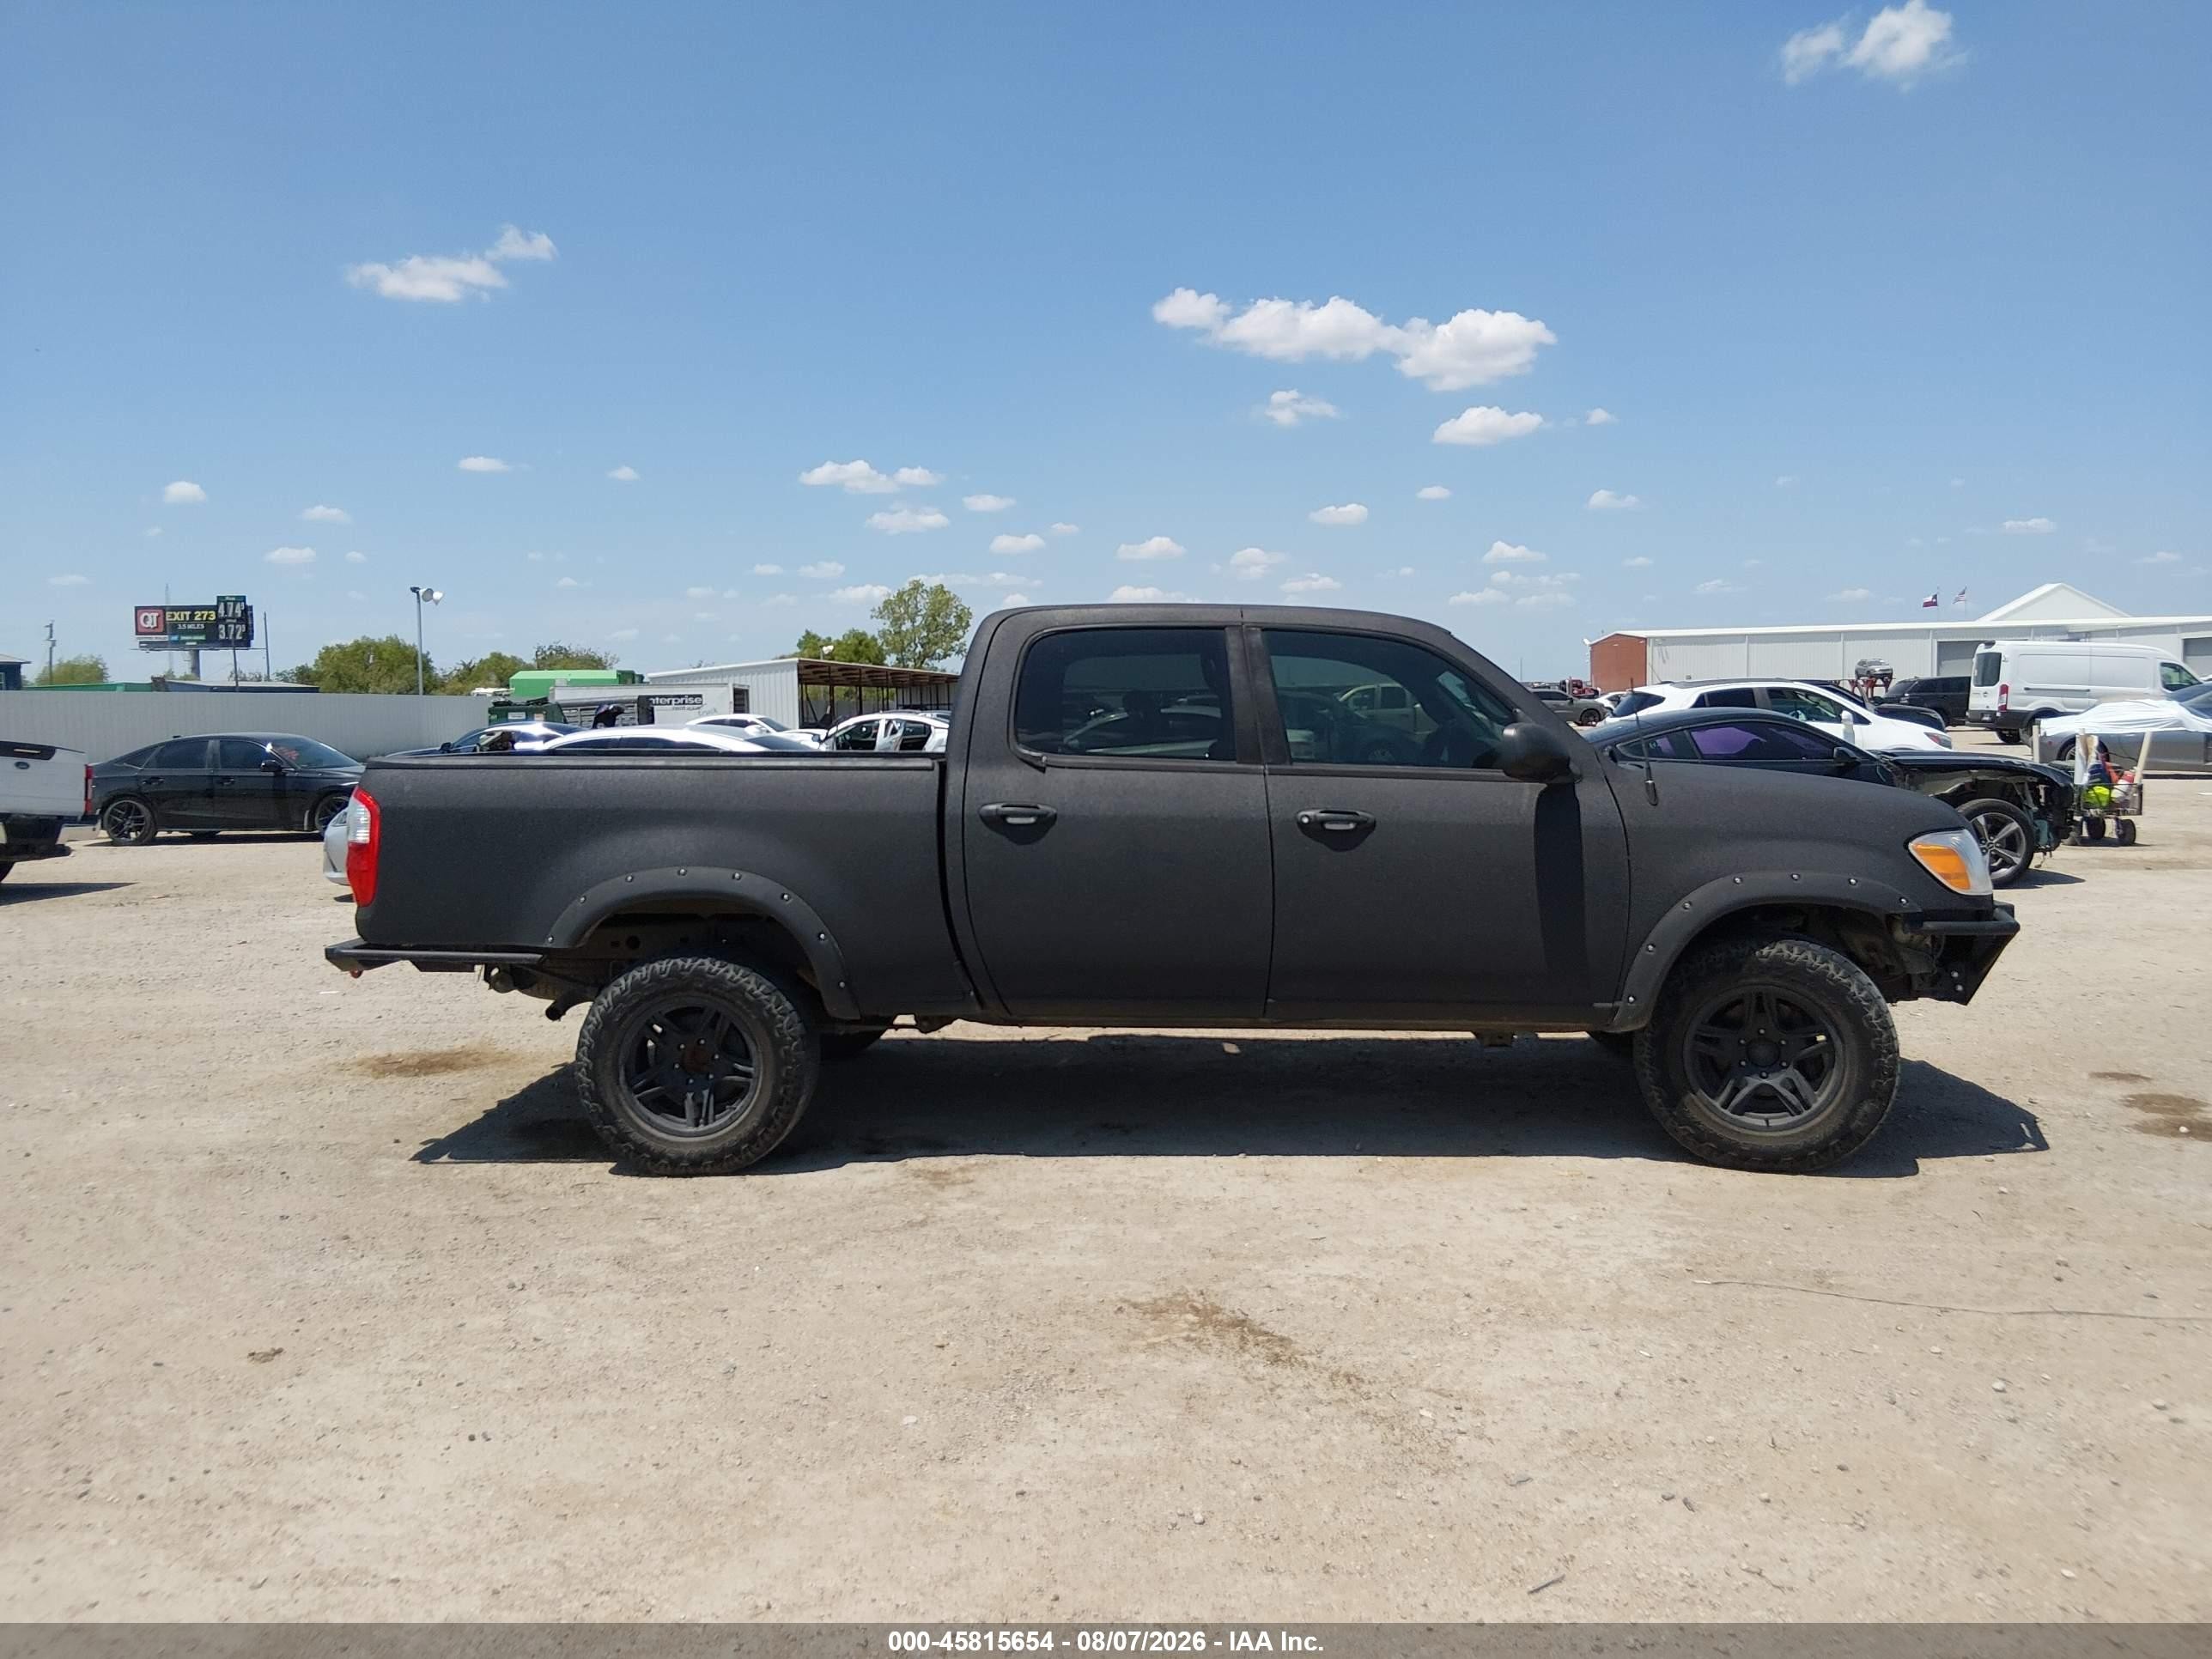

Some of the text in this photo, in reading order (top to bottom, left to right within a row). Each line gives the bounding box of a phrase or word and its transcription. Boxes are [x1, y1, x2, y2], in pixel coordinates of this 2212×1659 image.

[140, 612, 159, 629] QT
[166, 611, 191, 621] EXIT
[194, 611, 216, 621] 273
[649, 696, 702, 705] nterprise
